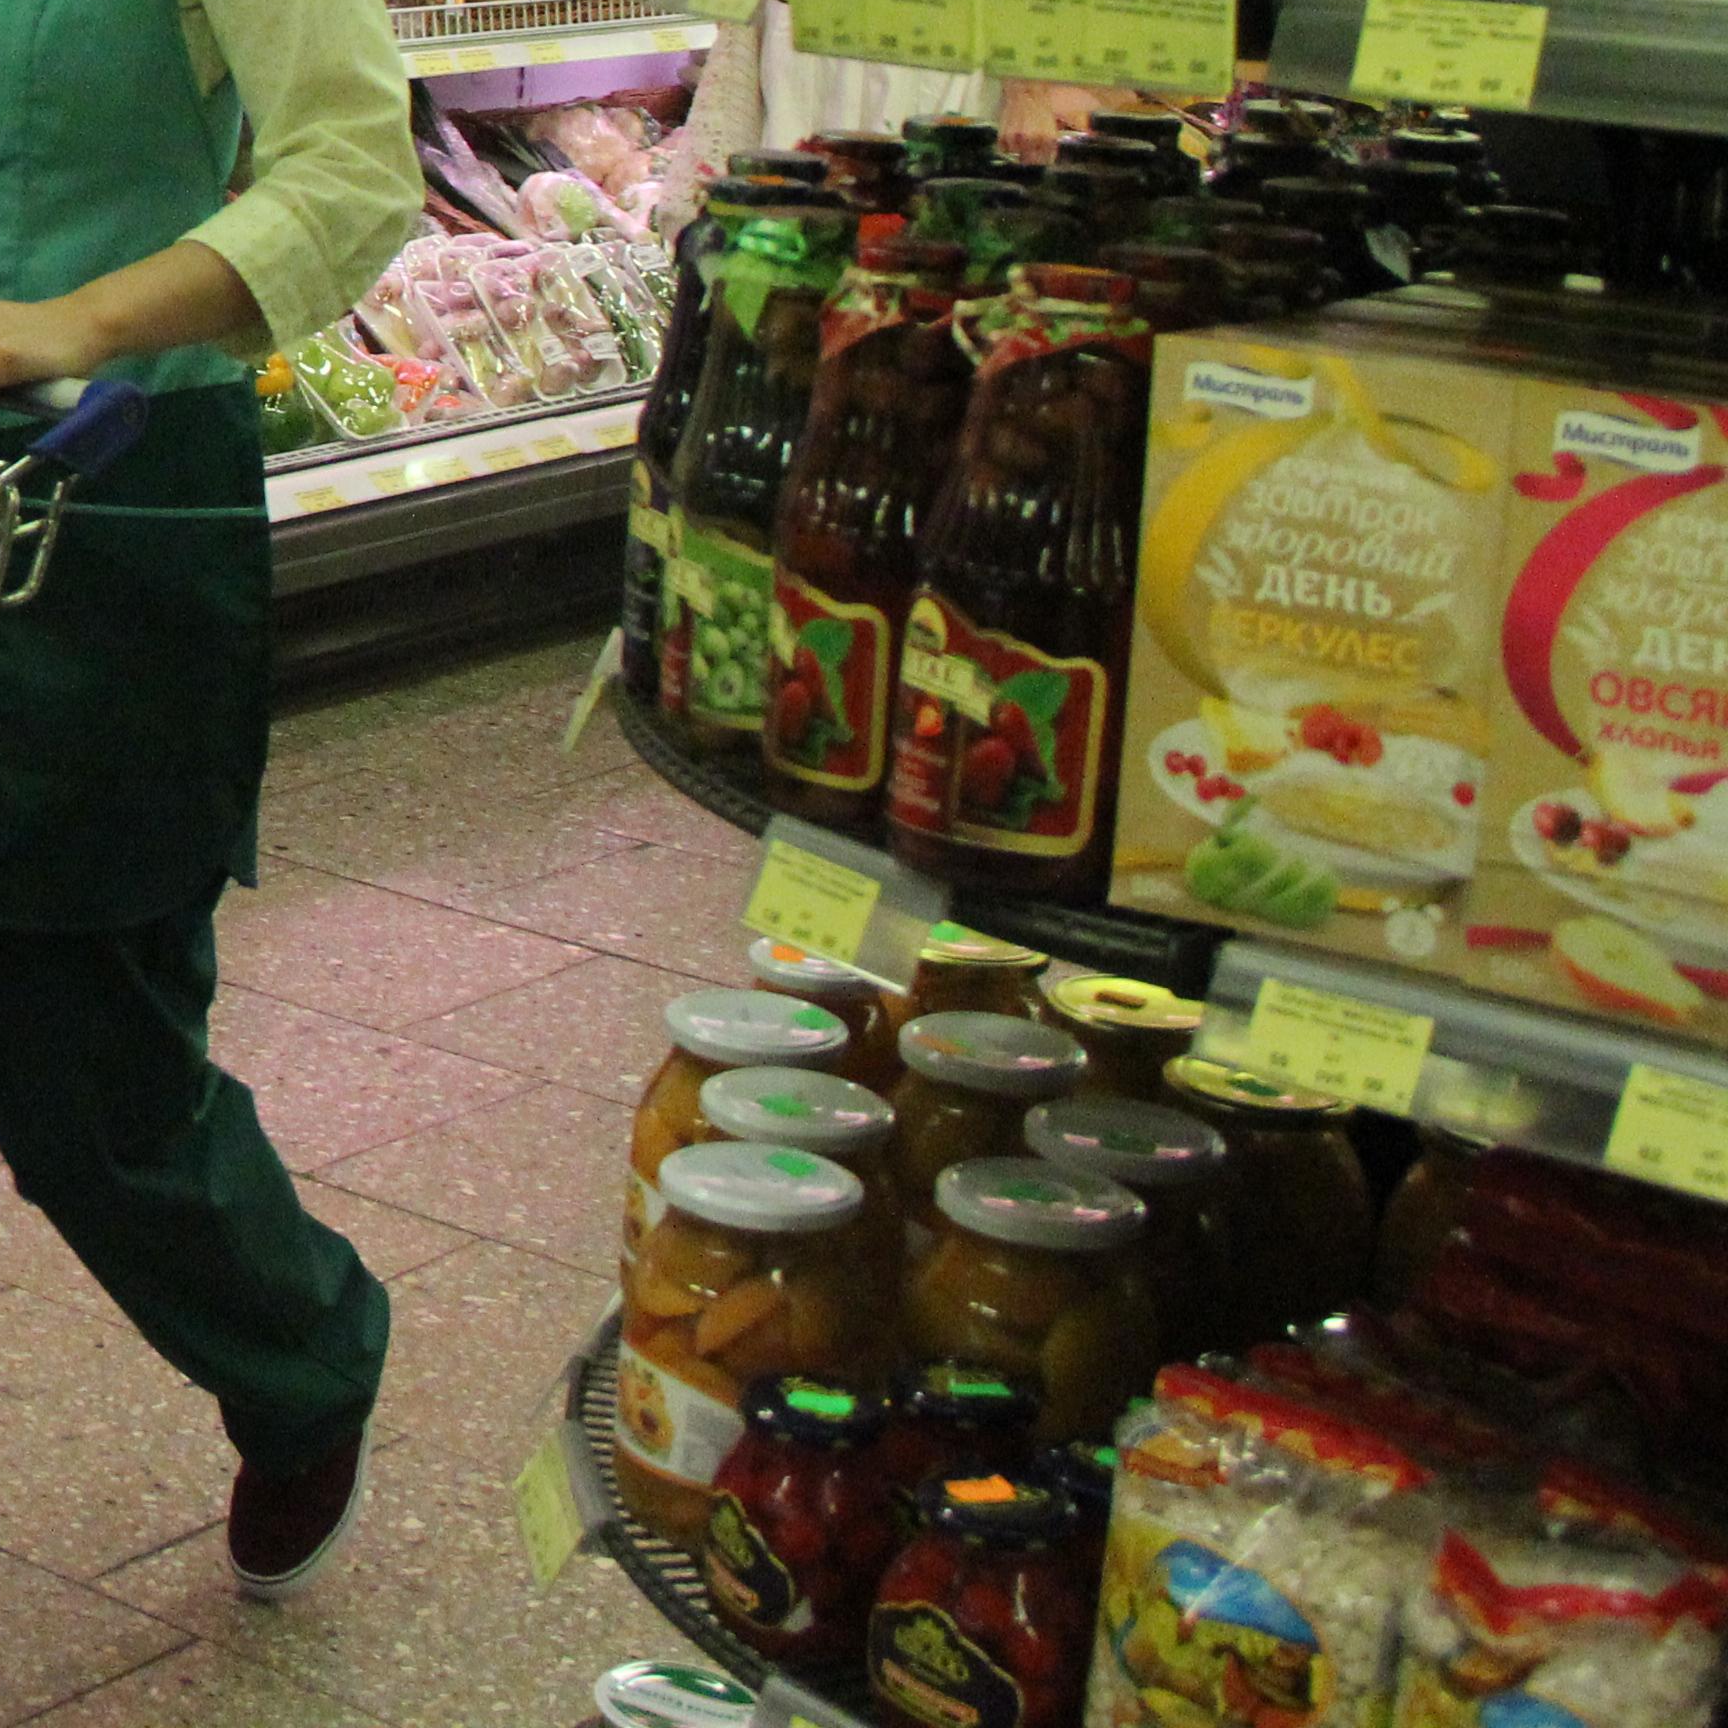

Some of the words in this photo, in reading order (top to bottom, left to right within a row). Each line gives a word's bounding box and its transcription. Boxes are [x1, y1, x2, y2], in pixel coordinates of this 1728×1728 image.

[1192, 371, 1305, 409] Мистраль
[1561, 421, 1690, 461] Мистраль
[1254, 565, 1395, 619] ДЕНЬ
